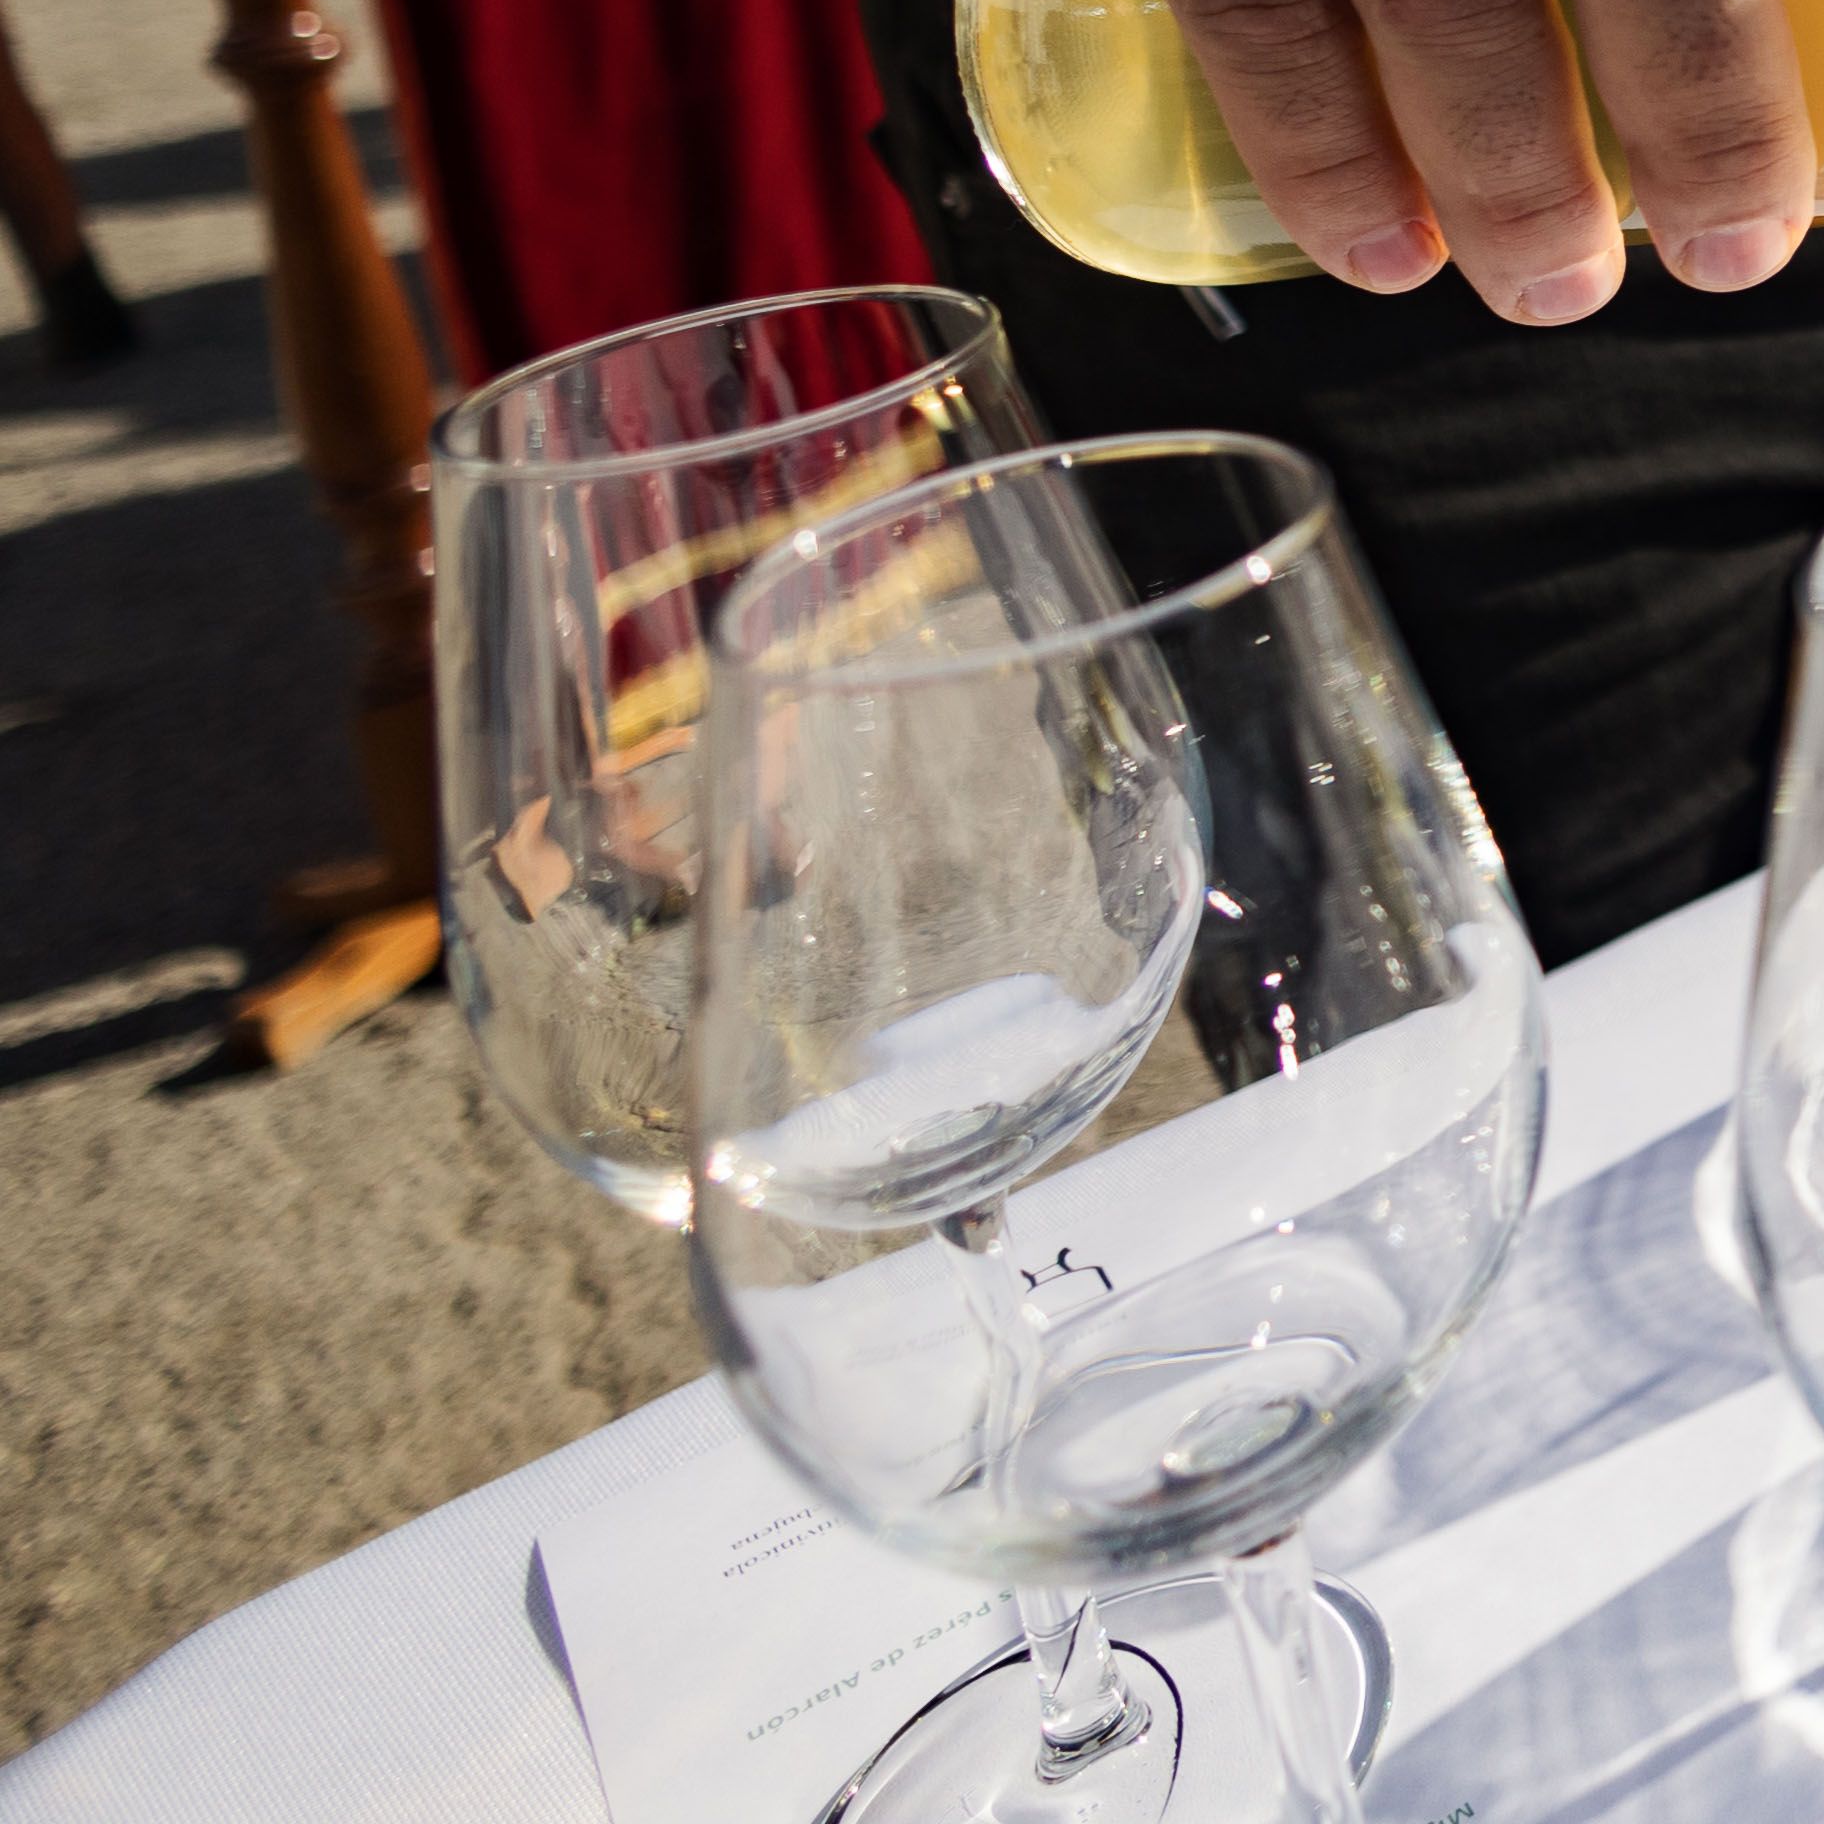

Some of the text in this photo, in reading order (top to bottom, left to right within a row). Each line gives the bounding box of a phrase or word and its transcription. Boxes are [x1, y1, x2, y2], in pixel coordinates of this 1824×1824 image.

[912, 1600, 992, 1650] Pérez
[870, 1647, 905, 1674] de
[746, 1670, 861, 1741] Alarcón
